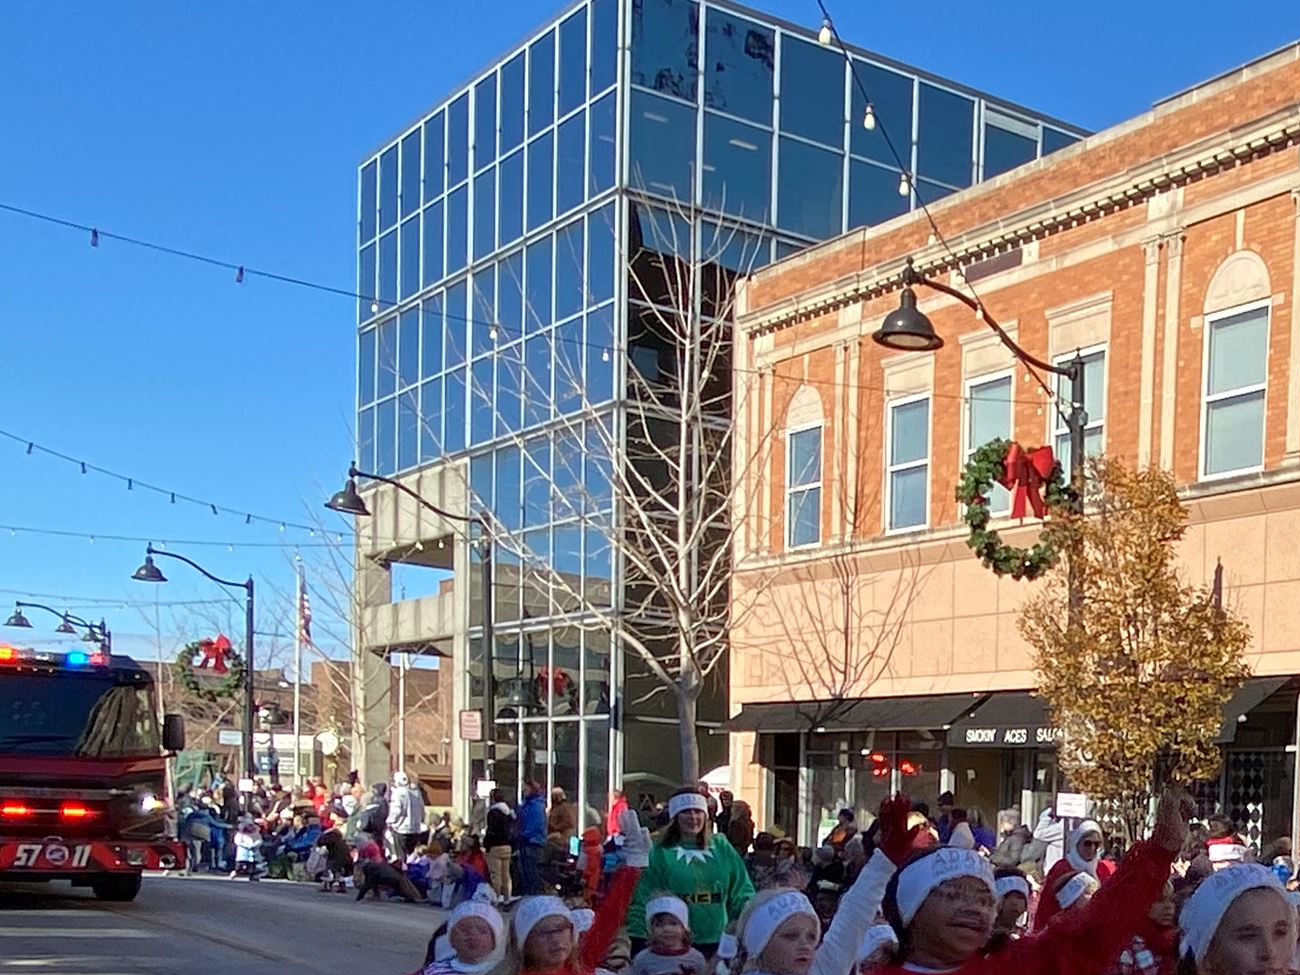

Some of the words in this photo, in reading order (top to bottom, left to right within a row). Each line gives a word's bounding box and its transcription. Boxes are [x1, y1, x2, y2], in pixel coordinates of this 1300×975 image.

[1003, 728, 1028, 743] ACES
[13, 844, 43, 866] 57
[72, 844, 92, 867] 11
